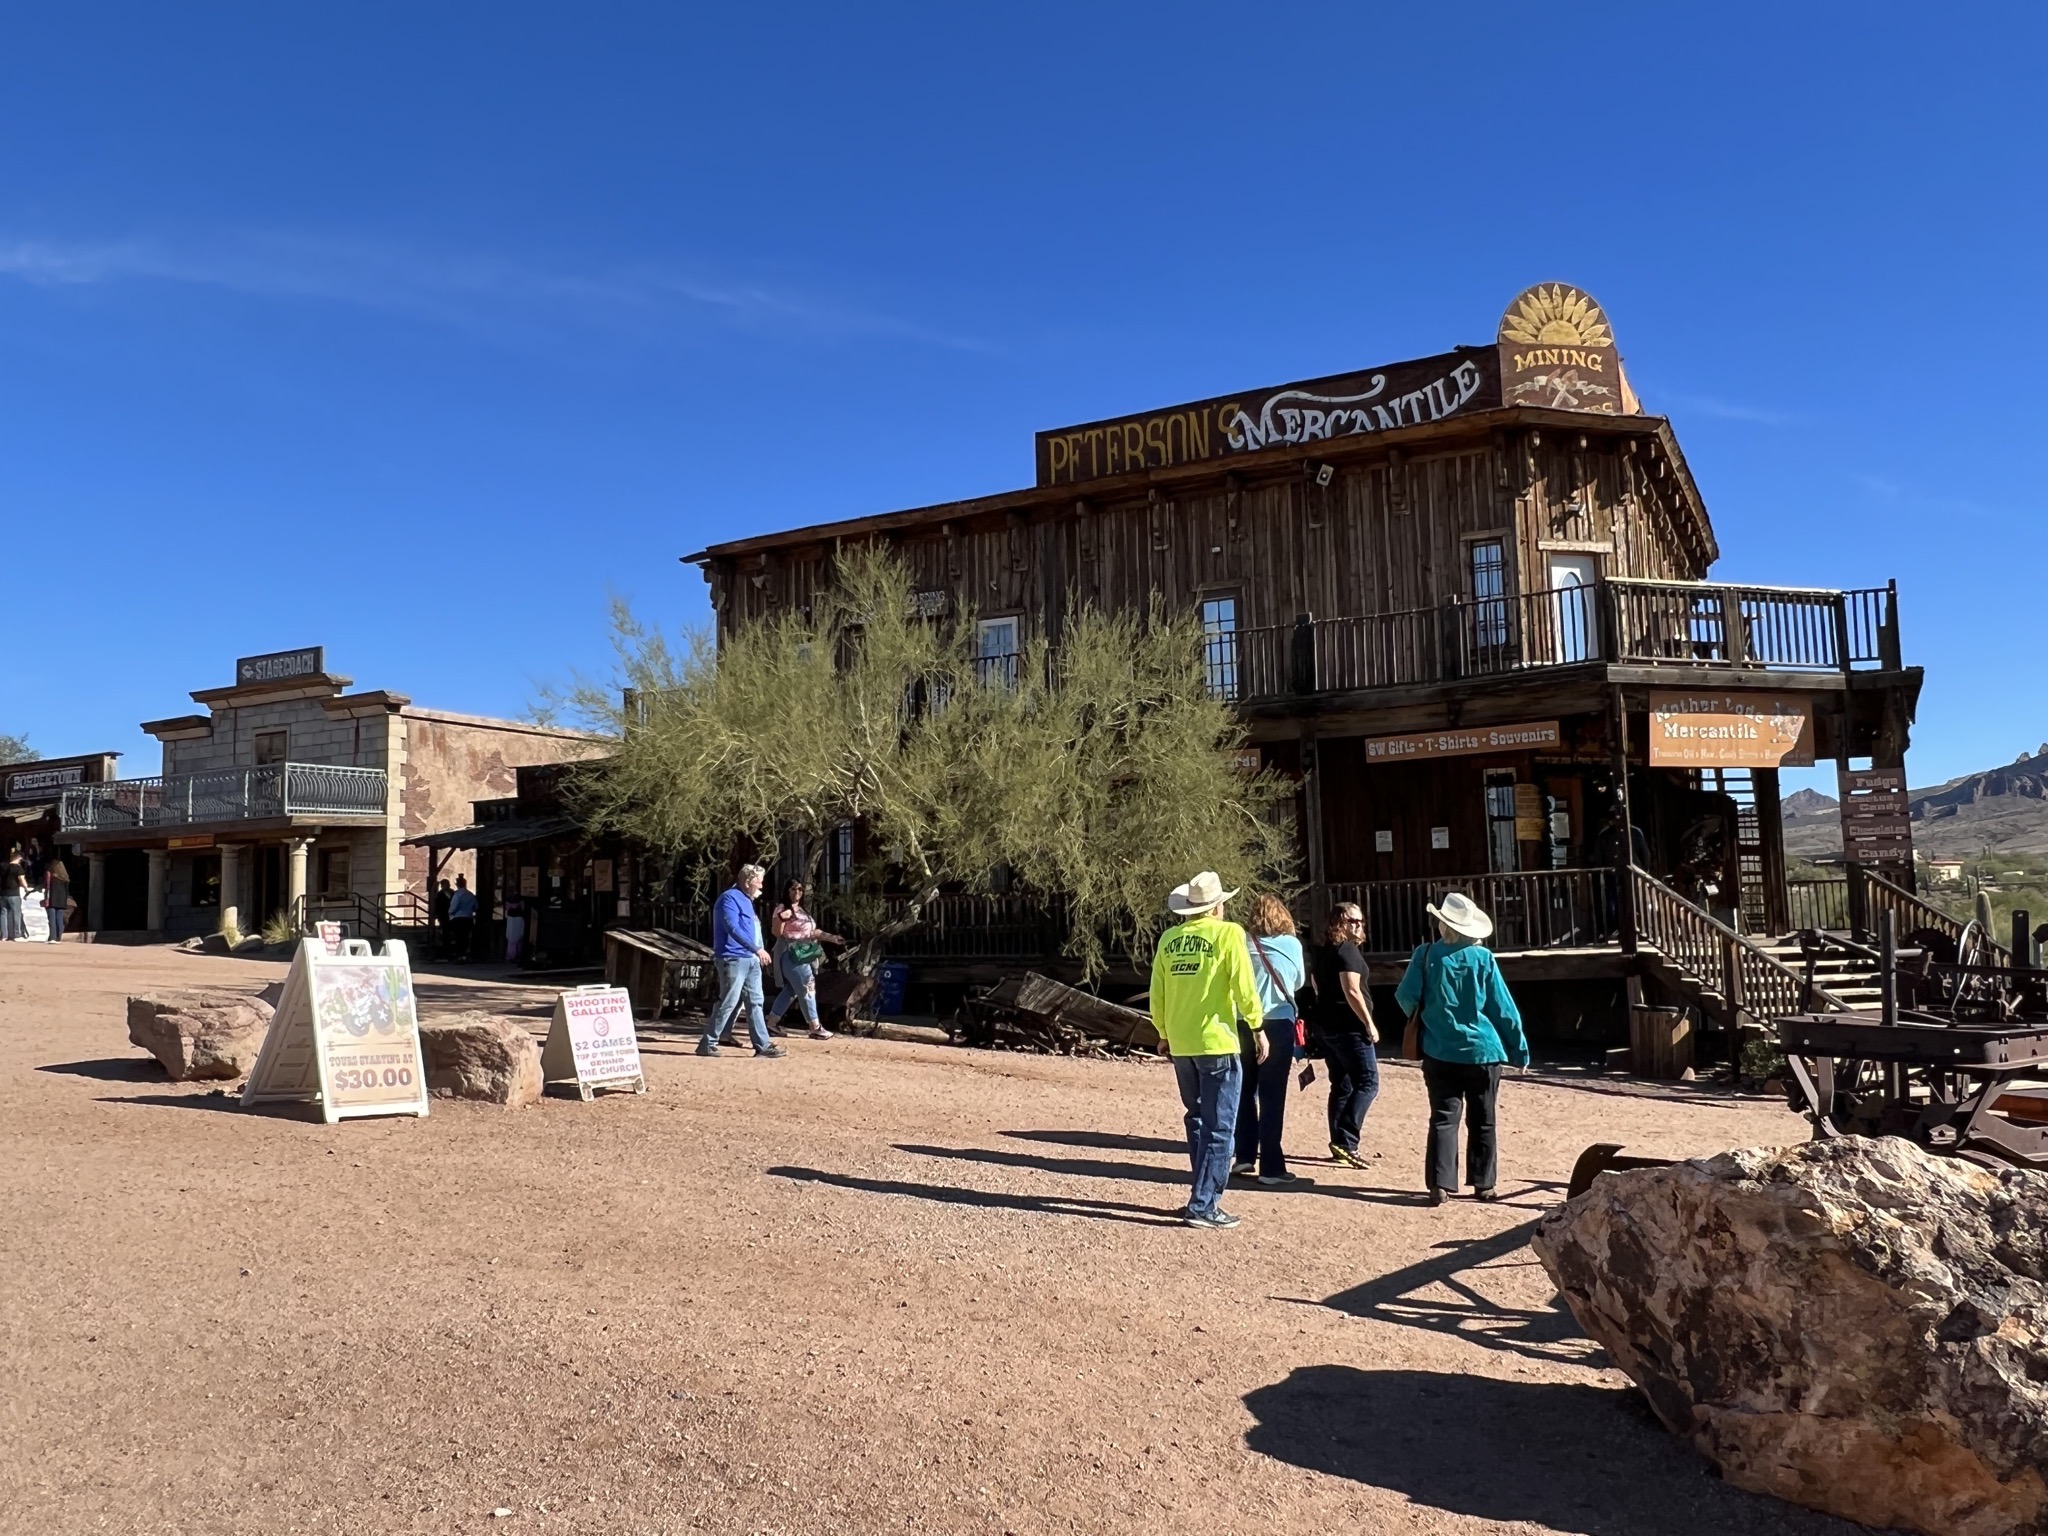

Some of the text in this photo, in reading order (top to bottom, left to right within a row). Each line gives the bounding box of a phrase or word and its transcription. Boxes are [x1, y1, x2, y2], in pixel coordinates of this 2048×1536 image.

[1514, 349, 1602, 373] MINING
[256, 654, 315, 680] STAGECOACH
[1655, 698, 1718, 723] Mother
[1664, 722, 1759, 740] Mercantile
[1368, 728, 1555, 757] SW Gifts T-Shirts Souvenirs
[13, 770, 81, 790] BORDERTOWN
[1856, 777, 1898, 788] Fudge
[1848, 795, 1894, 803] Cactus
[1859, 803, 1901, 811] Candy
[1849, 825, 1906, 836] Chocolates
[1858, 848, 1906, 859] Candy
[1183, 935, 1213, 953] POWER
[681, 965, 702, 977] FIRE
[568, 997, 627, 1009] SHOOTING
[571, 1005, 625, 1017] GALLERY
[575, 1037, 633, 1051] $2 GAMES
[329, 1053, 413, 1067] TOURS STARTING AT
[579, 1063, 639, 1078] THE CHURCH
[335, 1068, 413, 1091] $30.00
